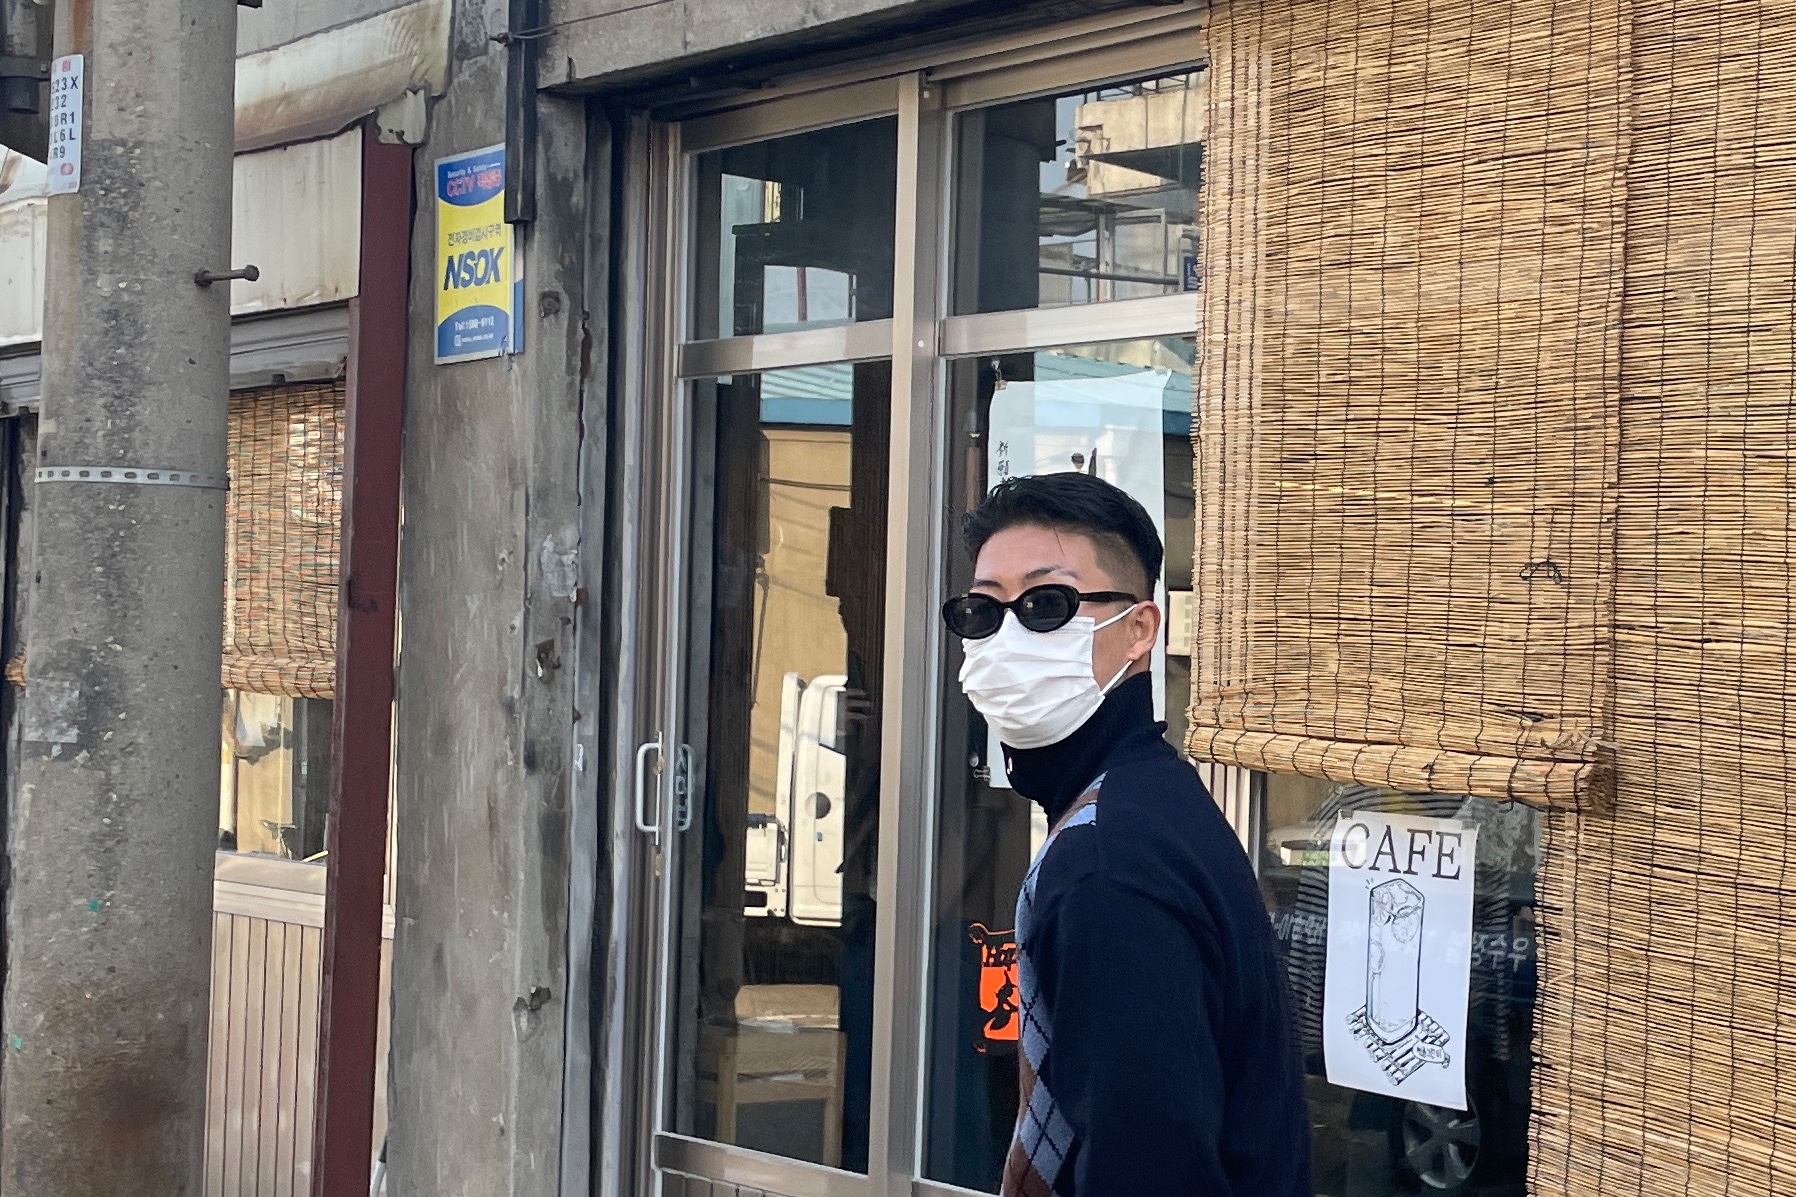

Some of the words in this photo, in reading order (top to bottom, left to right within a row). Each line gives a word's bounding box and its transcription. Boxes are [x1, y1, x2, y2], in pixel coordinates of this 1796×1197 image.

[447, 174, 475, 198] CCTV
[443, 246, 505, 291] NSOK
[1341, 822, 1462, 881] CAFE
